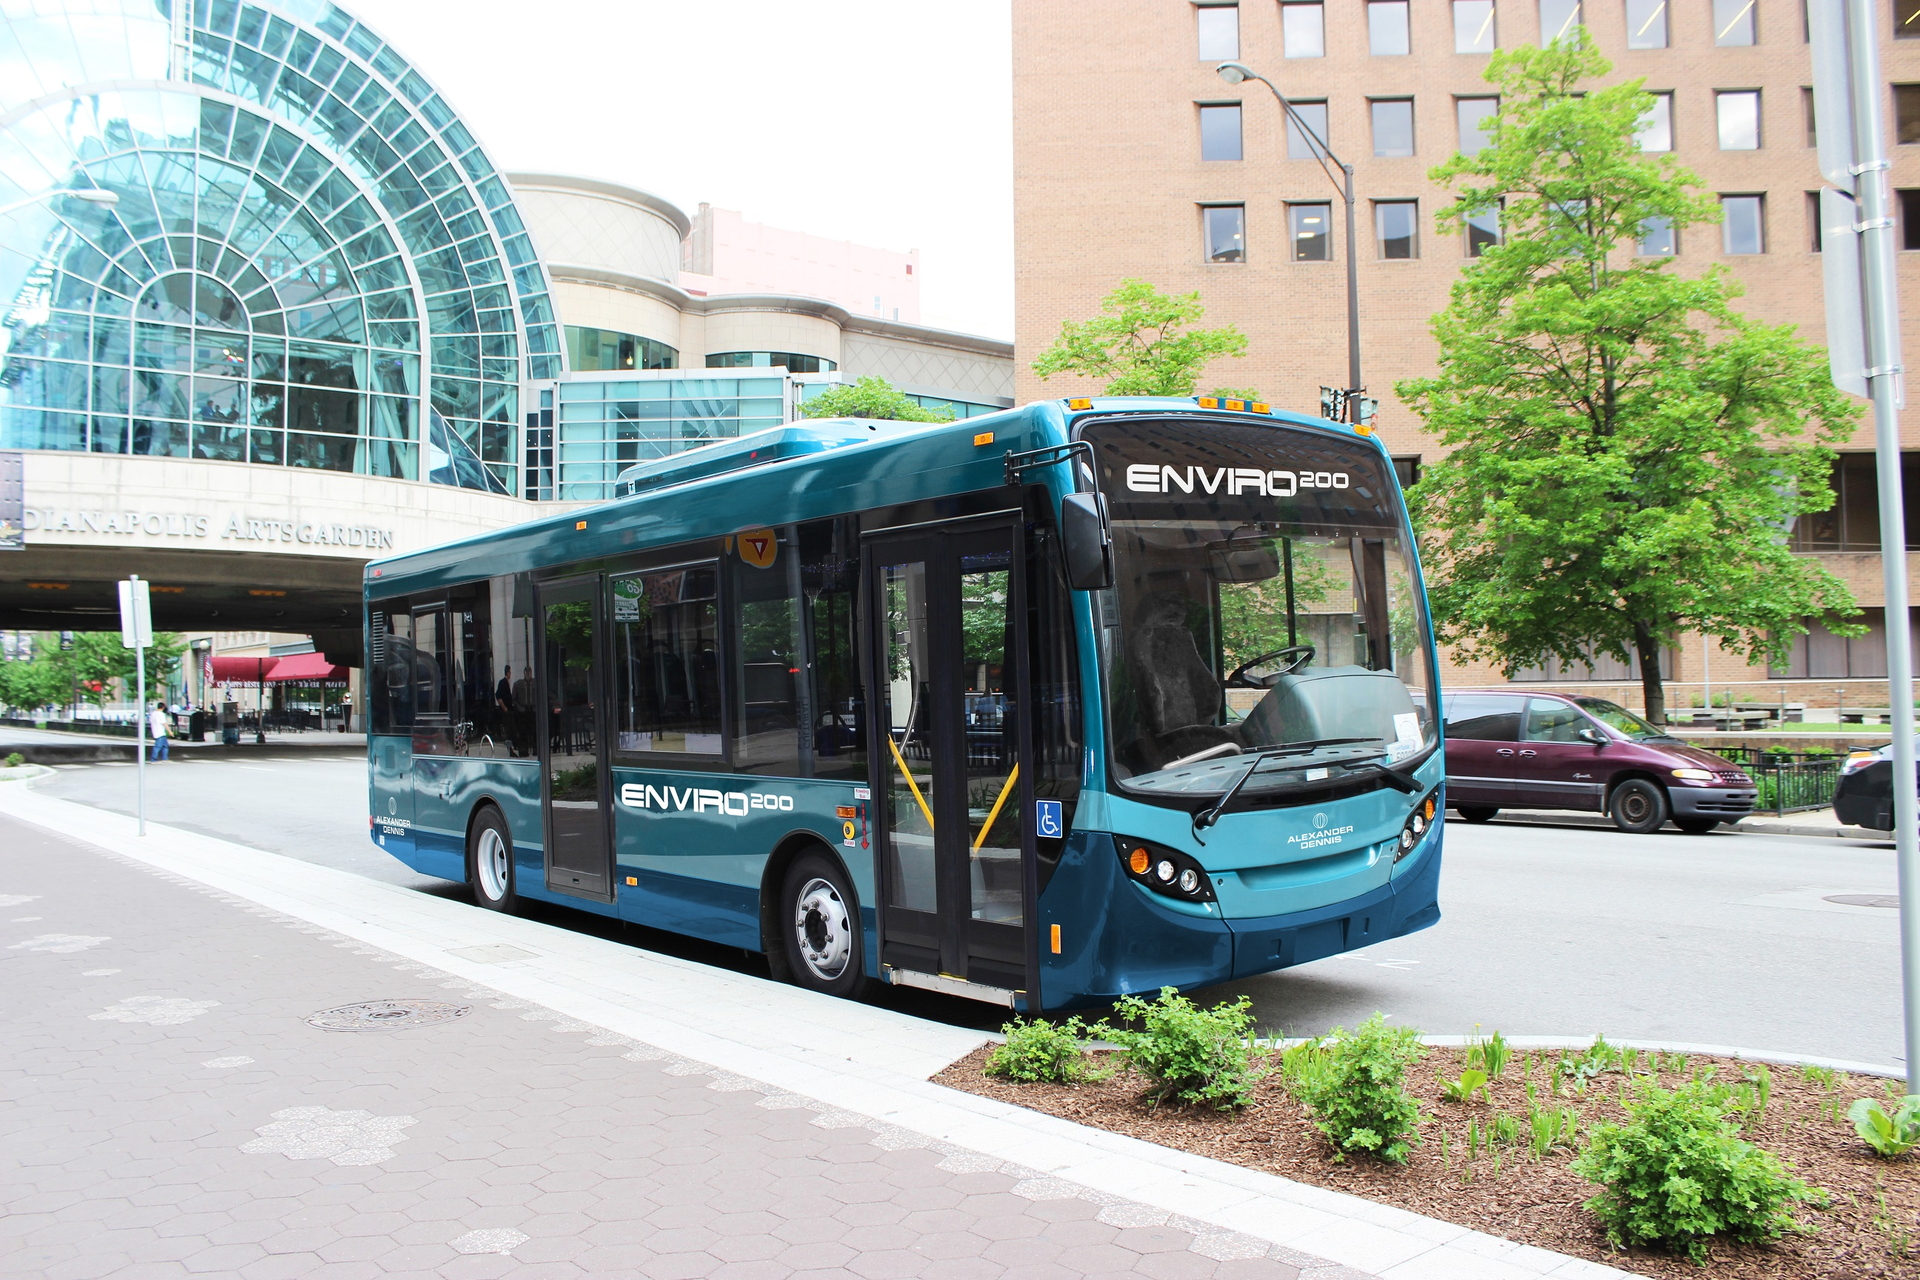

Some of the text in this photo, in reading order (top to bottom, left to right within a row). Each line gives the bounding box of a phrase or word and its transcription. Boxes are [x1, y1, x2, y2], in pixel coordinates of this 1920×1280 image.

[221, 512, 394, 549] ARTSGARDEN
[376, 815, 411, 828] ALEXANDER
[382, 825, 405, 836] DENNIS
[1286, 825, 1354, 844] ALEXANDER
[1300, 835, 1342, 850] DENNIS
